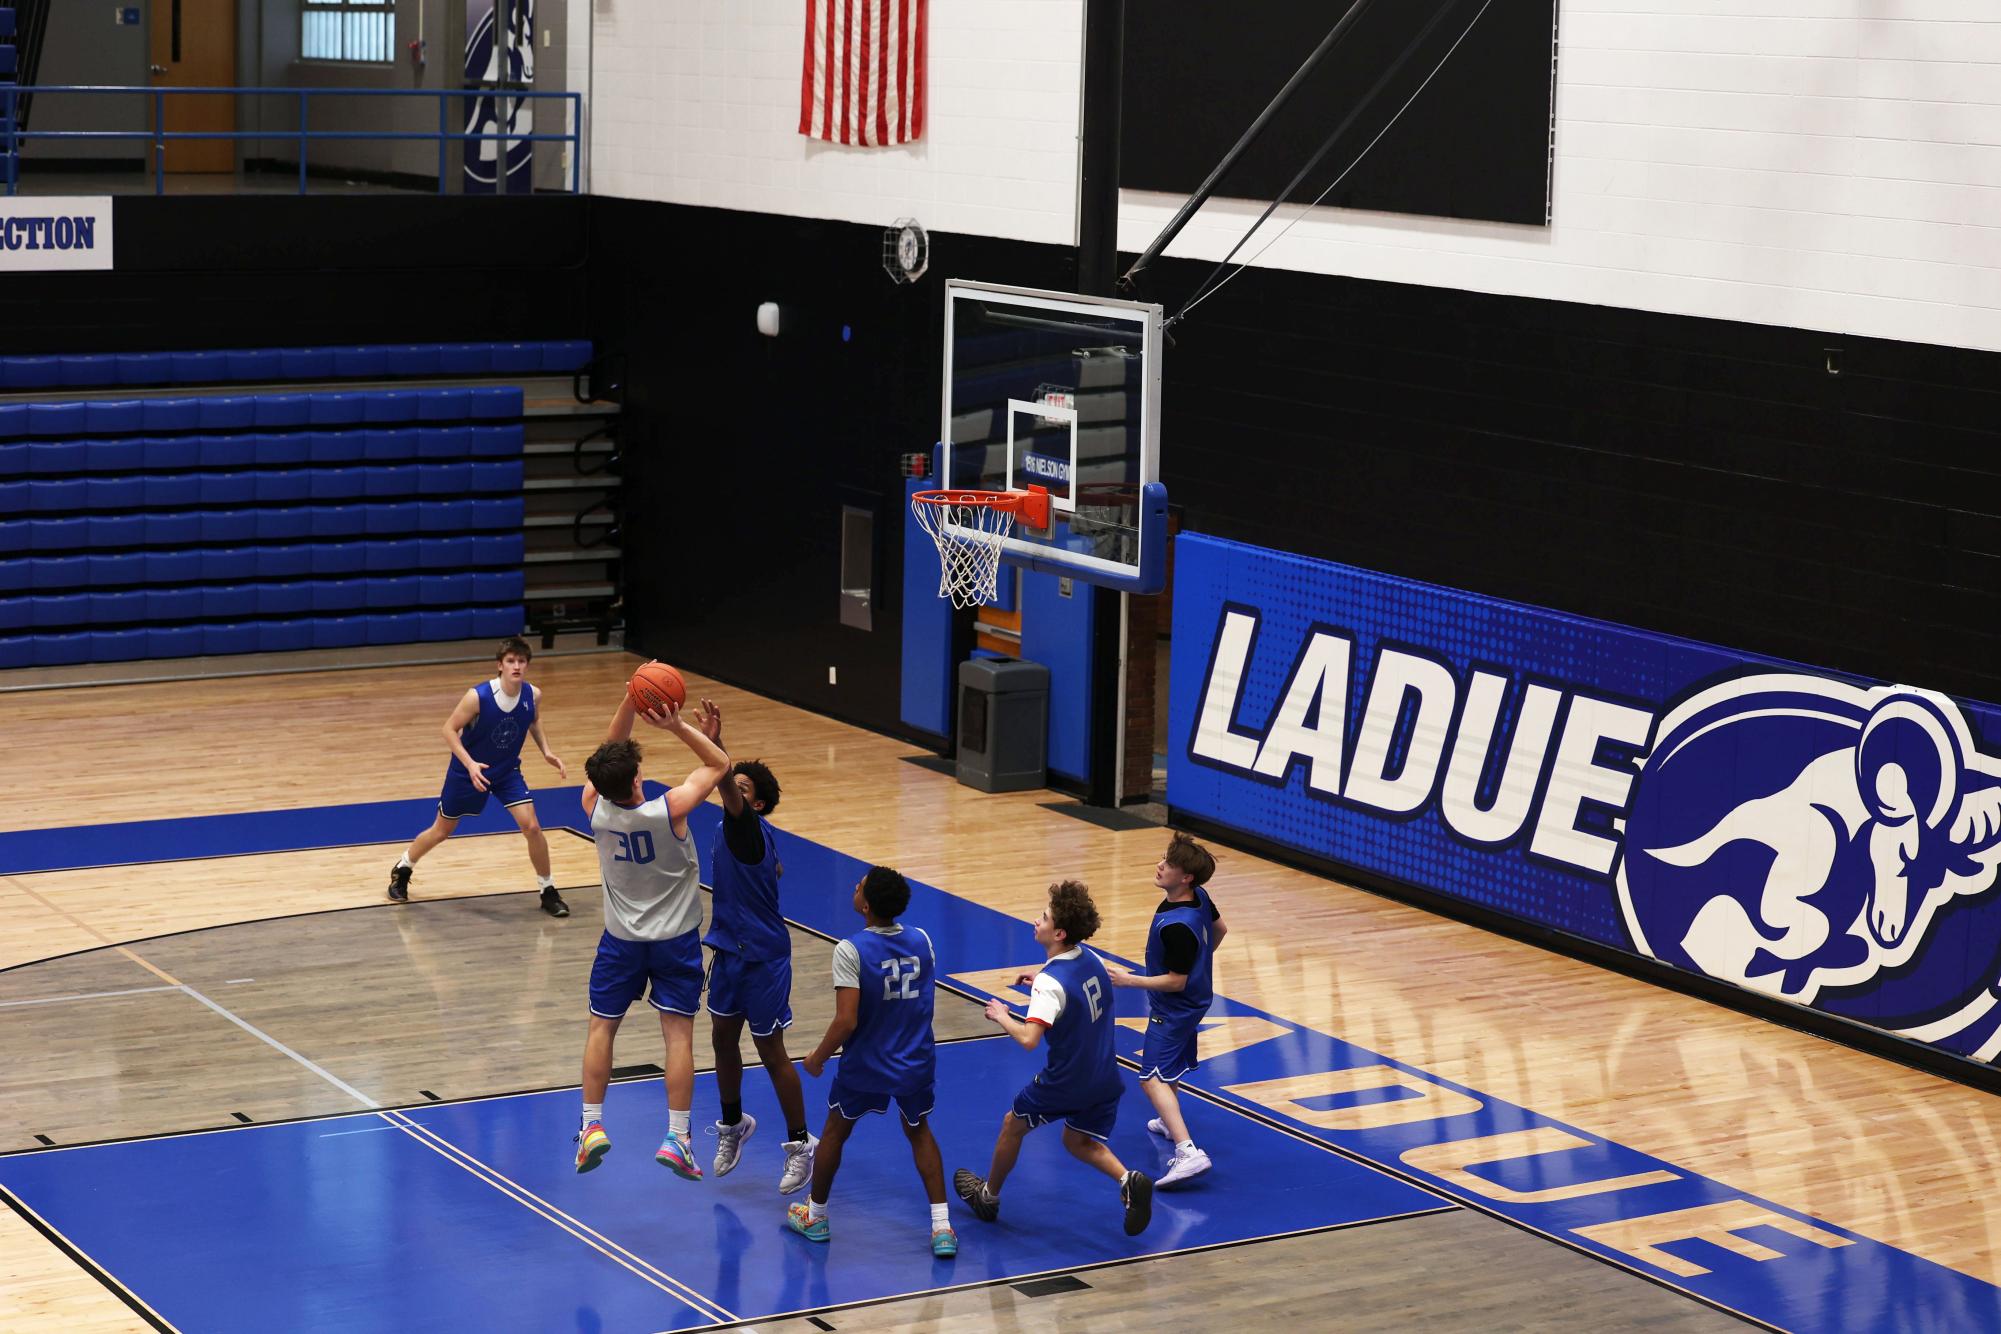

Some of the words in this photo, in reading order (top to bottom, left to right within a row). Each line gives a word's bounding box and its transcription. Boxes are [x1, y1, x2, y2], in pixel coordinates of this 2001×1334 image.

[0, 216, 95, 250] CTION
[1192, 611, 1654, 875] LADUE
[609, 830, 656, 865] 30
[881, 956, 920, 1000] 22
[1083, 976, 1102, 1024] 12
